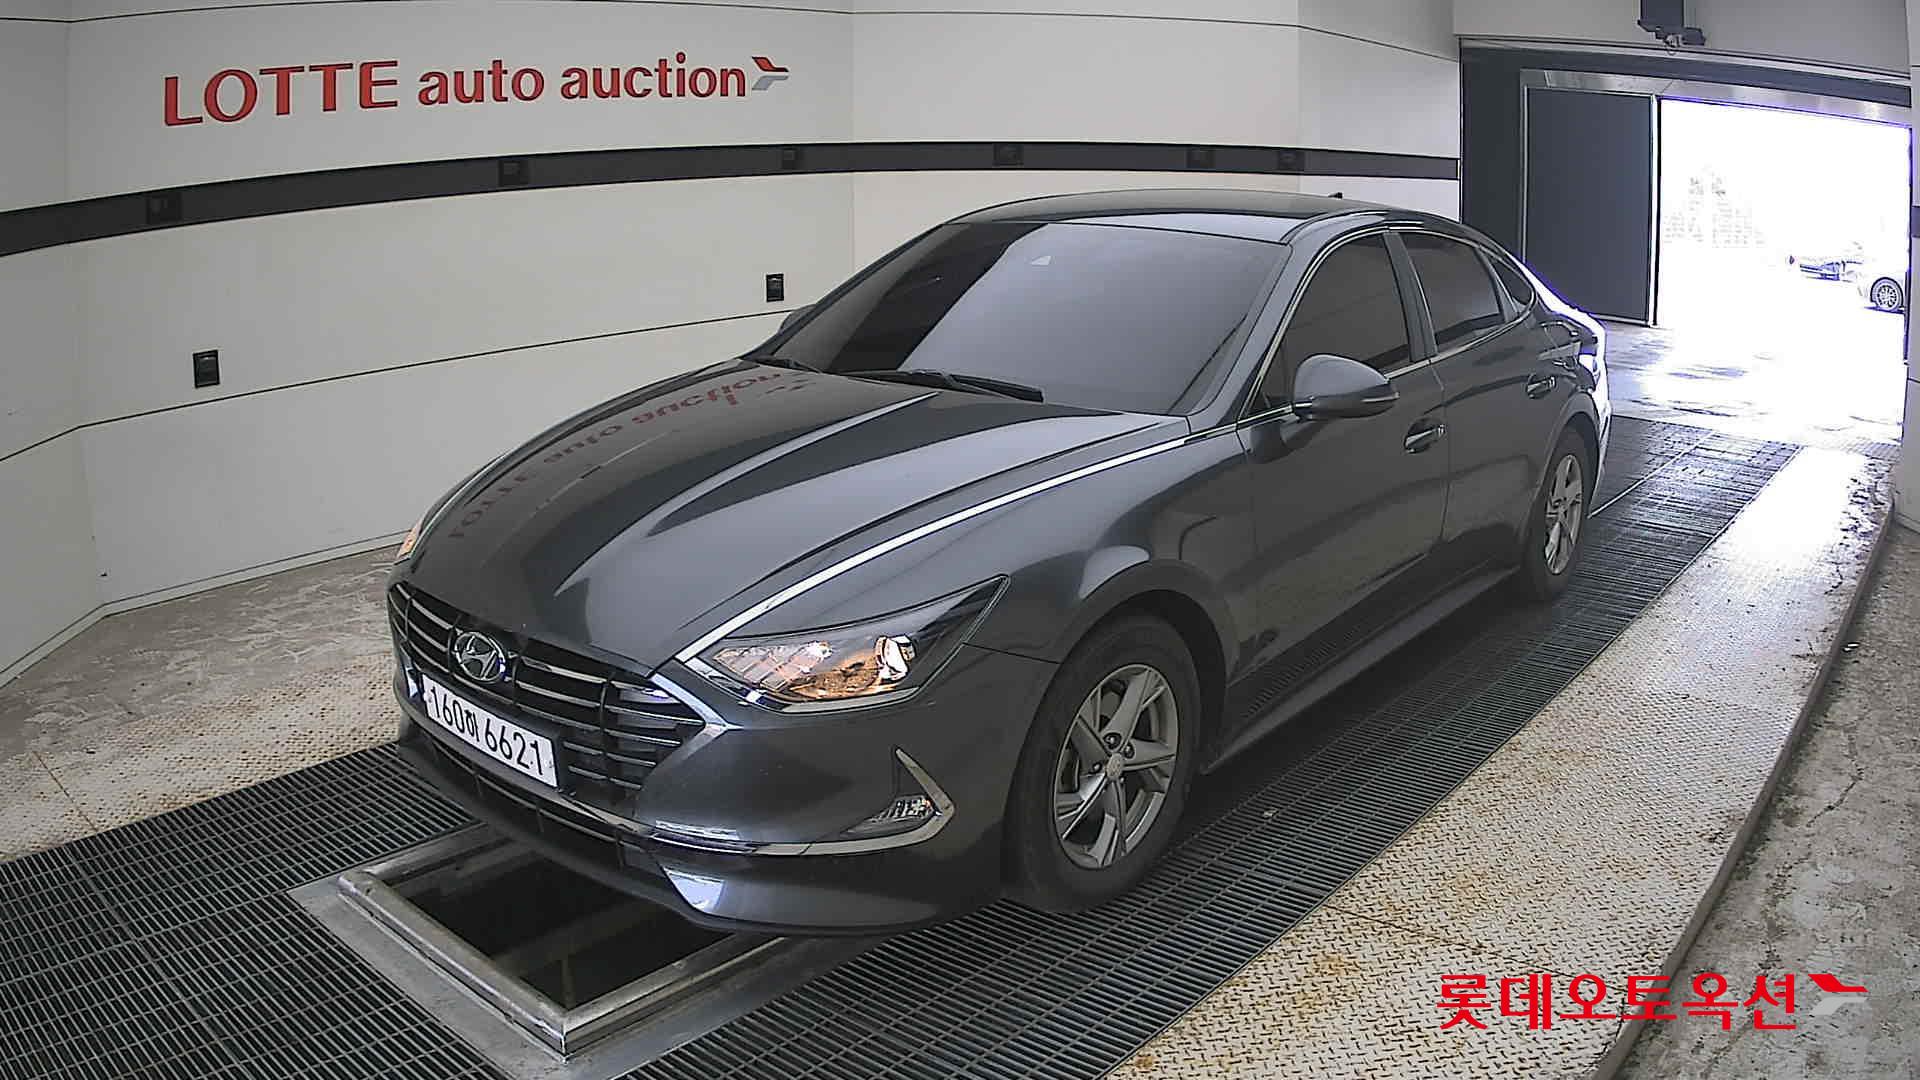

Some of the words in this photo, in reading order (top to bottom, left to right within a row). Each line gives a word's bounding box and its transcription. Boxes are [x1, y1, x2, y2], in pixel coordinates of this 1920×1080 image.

[164, 60, 399, 126] LOTTE
[418, 59, 545, 105] auto
[560, 52, 747, 99] auction
[485, 718, 543, 776] 6621
